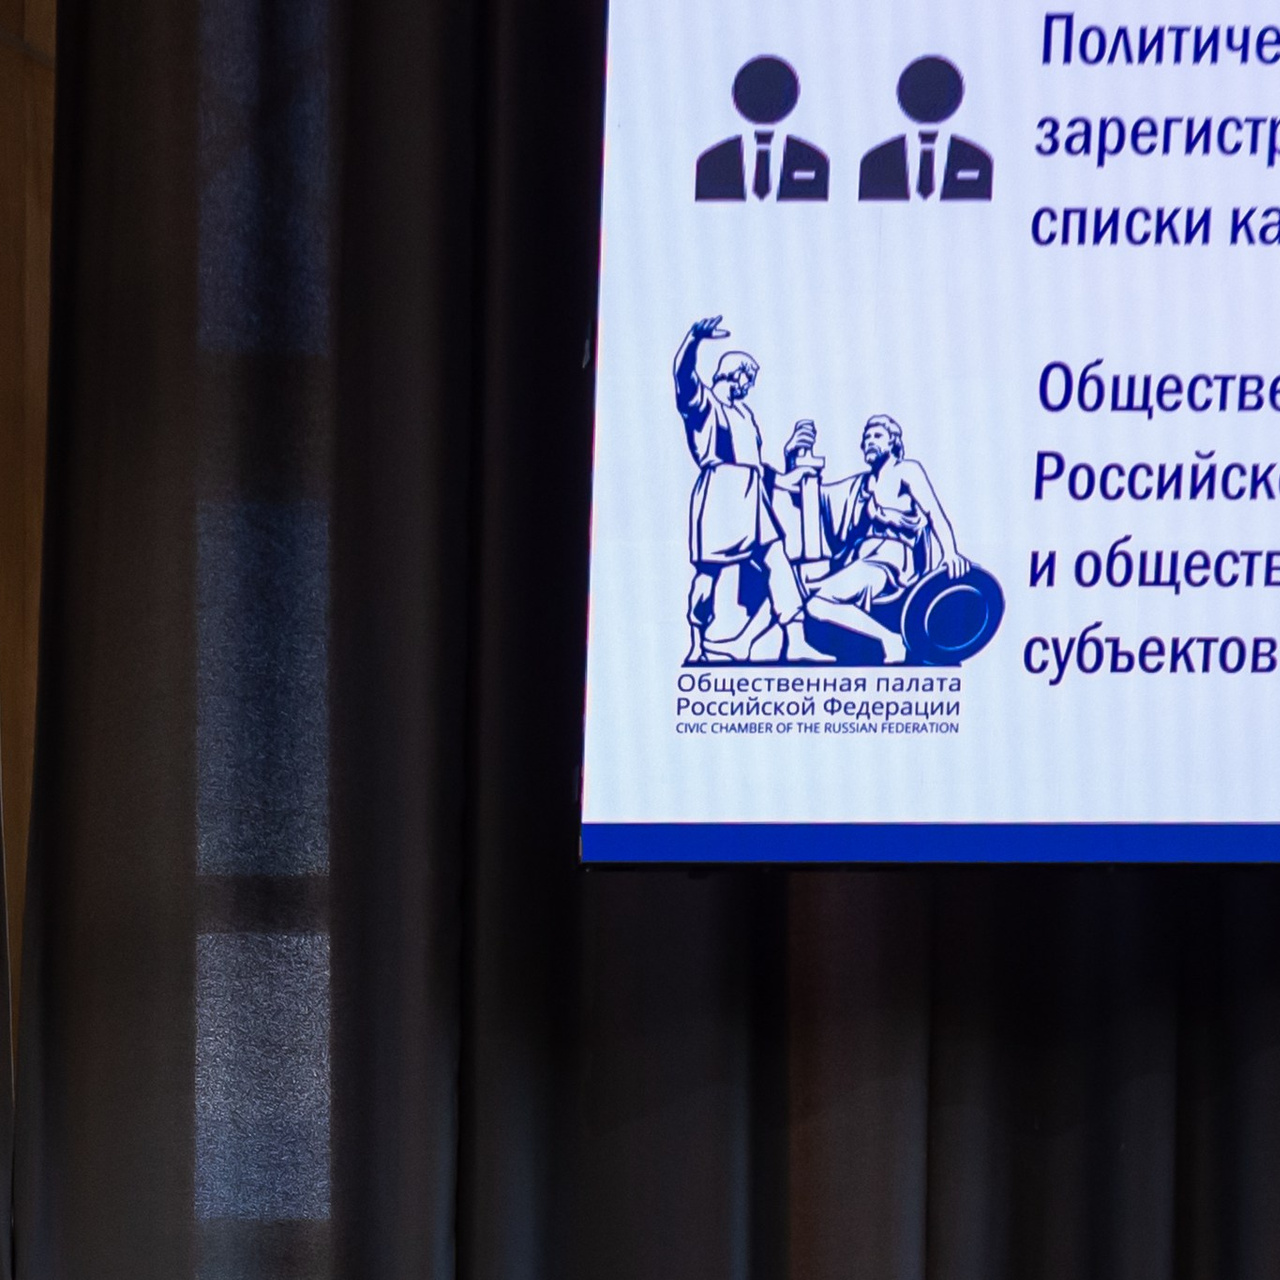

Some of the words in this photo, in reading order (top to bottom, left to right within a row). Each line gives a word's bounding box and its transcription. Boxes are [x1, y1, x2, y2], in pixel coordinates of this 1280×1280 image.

[1042, 12, 1280, 65] Политиче
[1031, 206, 1212, 246] списки
[1230, 207, 1280, 246] ка
[1034, 450, 1280, 501] Российск
[1029, 550, 1056, 587] и
[1023, 621, 1277, 686] субъектов
[677, 672, 867, 696] Общественная
[876, 677, 961, 692] палата
[676, 696, 815, 716] Российской
[823, 697, 960, 720] Федерации
[676, 722, 708, 734] CIVIC
[711, 722, 773, 734] CHAMBER
[776, 722, 793, 734] OF
[798, 722, 820, 734] THE
[824, 722, 878, 734] RUSSIAN
[881, 722, 959, 734] FEDERATION
